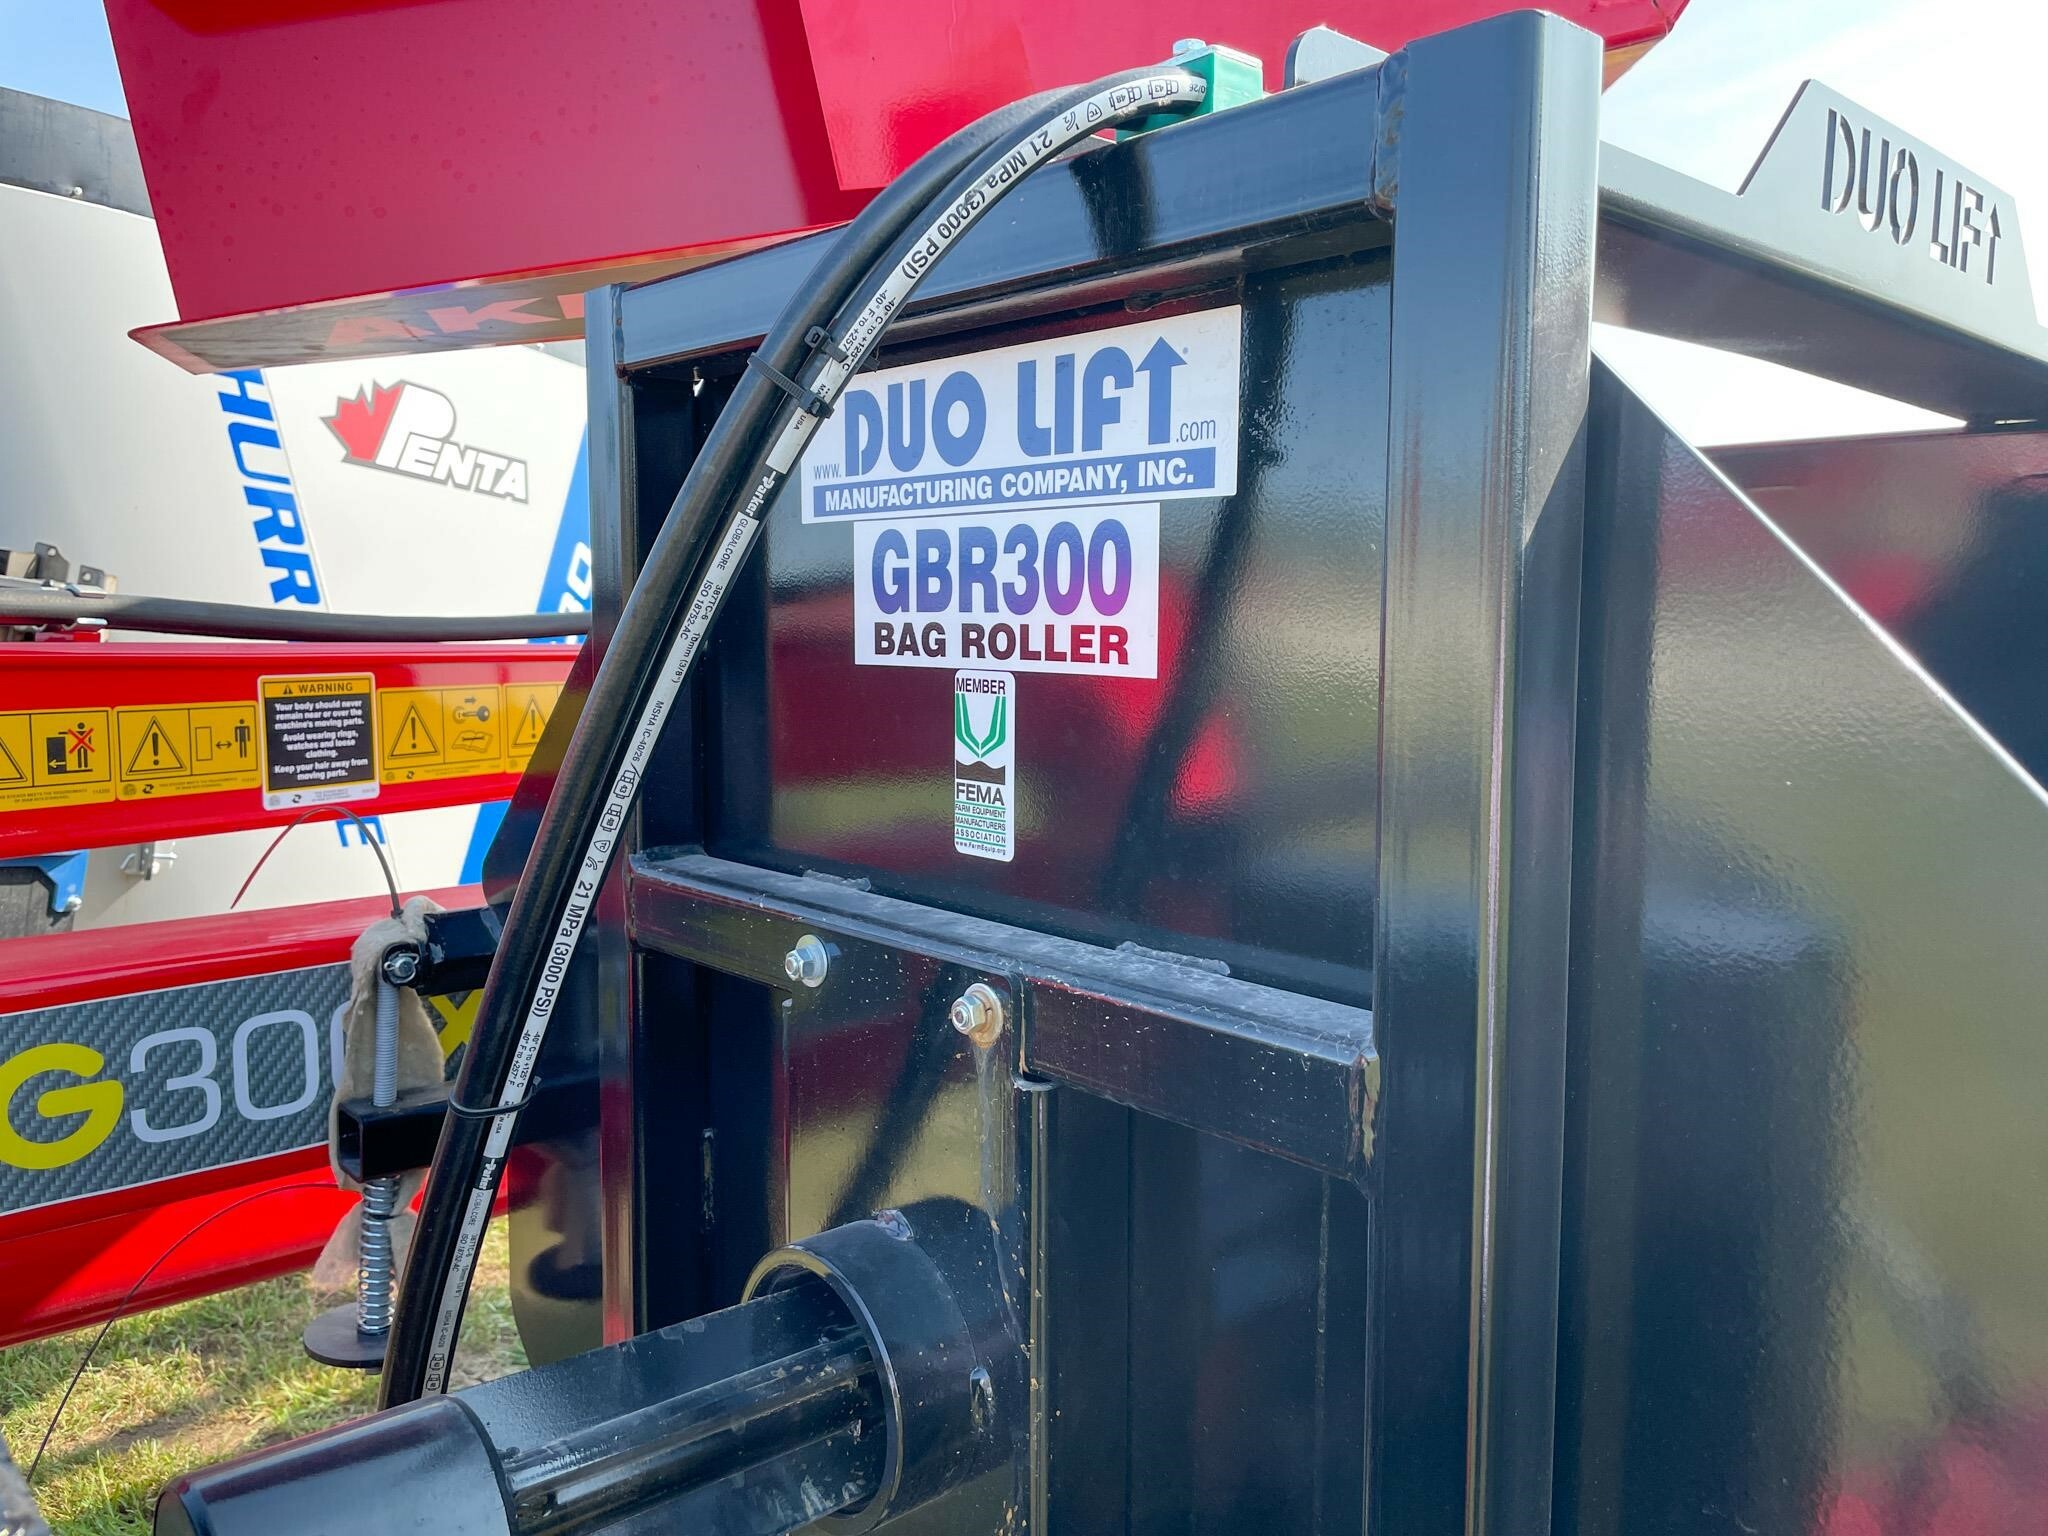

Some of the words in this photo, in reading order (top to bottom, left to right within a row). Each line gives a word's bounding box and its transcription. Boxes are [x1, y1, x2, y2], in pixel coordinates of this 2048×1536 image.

[1027, 129, 1054, 156] 21
[985, 151, 1027, 189] MPa
[1821, 107, 1920, 246] DUO
[1929, 167, 2002, 286] LIFT
[937, 189, 986, 240] (3000
[901, 237, 940, 280] PSI)
[867, 308, 876, 318] F
[875, 316, 884, 326] C
[841, 362, 851, 372] C
[813, 463, 842, 480] www.
[844, 370, 987, 477] DUO
[1017, 335, 1188, 457] LIFT
[1175, 416, 1216, 443] .com
[745, 470, 777, 517] Parker
[824, 475, 993, 513] MANUFACTURING
[1000, 463, 1128, 498] COMPANY,
[1137, 456, 1194, 488] INC.
[717, 518, 749, 571] GLOBALCORE
[871, 518, 1132, 617] GBR300
[700, 580, 714, 598] ISO
[680, 599, 703, 640] 18752-AC
[874, 621, 947, 658] BAG
[961, 623, 1129, 665] ROLLER
[297, 682, 354, 694] WARNING
[955, 677, 1006, 695] MEMBER
[274, 703, 293, 712] Your
[293, 702, 315, 711] body
[315, 700, 341, 710] should
[341, 700, 363, 708] never
[275, 712, 304, 721] remain
[304, 711, 322, 719] near
[322, 710, 332, 718] or
[332, 709, 350, 717] over
[350, 708, 363, 717] the
[646, 699, 665, 726] MSHA
[274, 719, 314, 730] machine's
[314, 718, 343, 728] moving
[343, 716, 365, 727] parts.
[282, 732, 306, 742] Avoid
[306, 730, 337, 741] wearing
[337, 729, 360, 739] rings,
[286, 741, 320, 751] watches
[319, 740, 335, 748] and
[335, 739, 357, 747] loose
[305, 749, 339, 759] clothing.
[274, 764, 295, 774] Keep
[296, 763, 314, 773] your
[314, 761, 330, 770] hair
[330, 760, 351, 769] away
[351, 757, 369, 767] from
[297, 771, 326, 780] moving
[326, 769, 349, 780] parts.
[955, 781, 1005, 807] FEMA
[955, 803, 971, 815] FARM
[971, 806, 1006, 819] EQUIPMENT
[955, 815, 1006, 832] MANUFACTURERS
[955, 827, 1006, 844] ASSOCIATION
[574, 879, 594, 899] 21
[559, 903, 586, 938] MPa
[544, 942, 573, 983] (3000
[532, 986, 556, 1018] PSI)
